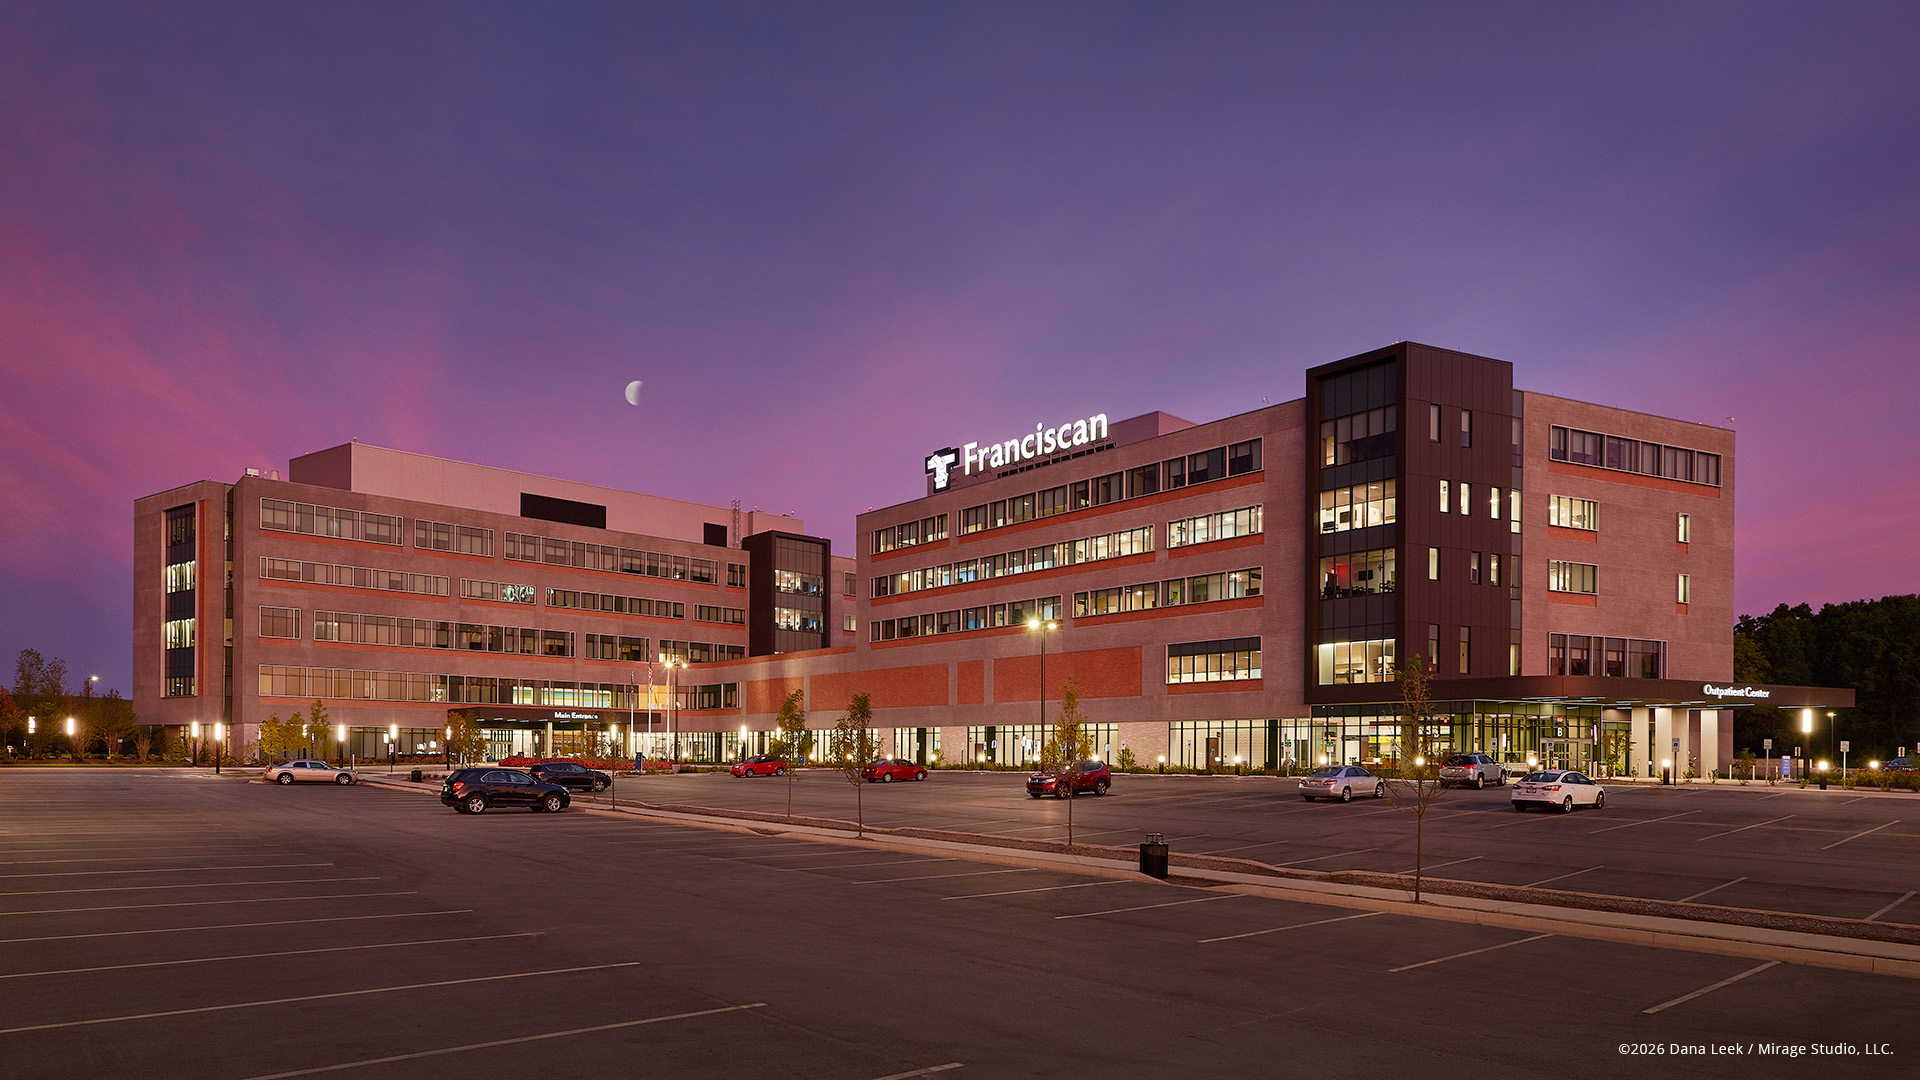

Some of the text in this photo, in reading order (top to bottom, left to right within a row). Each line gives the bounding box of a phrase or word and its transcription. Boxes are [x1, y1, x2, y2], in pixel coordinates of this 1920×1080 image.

[963, 413, 1109, 476] Franciscan
[1703, 684, 1770, 699] Outpatient Center
[554, 711, 599, 720] Main Entrance
[1557, 727, 1563, 737] B
